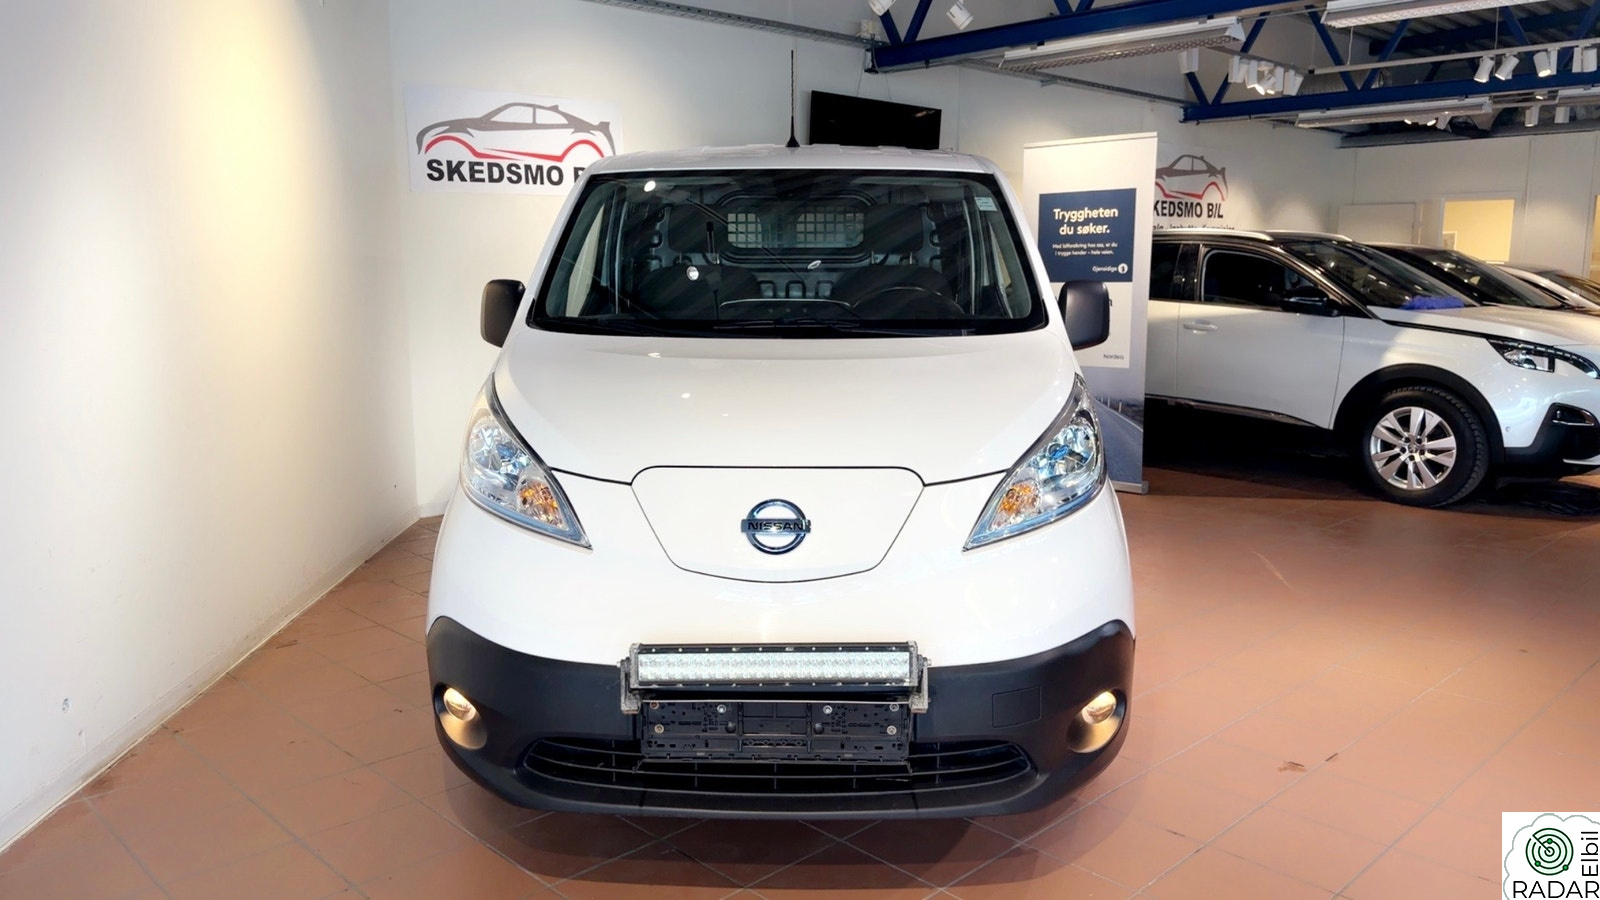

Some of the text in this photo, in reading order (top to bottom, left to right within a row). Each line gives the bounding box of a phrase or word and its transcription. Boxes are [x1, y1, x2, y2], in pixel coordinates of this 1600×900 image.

[426, 158, 564, 187] SKEDSMO
[1053, 207, 1119, 222] Tryggheten
[1059, 223, 1110, 235] du søker.
[747, 521, 804, 531] NISSAN
